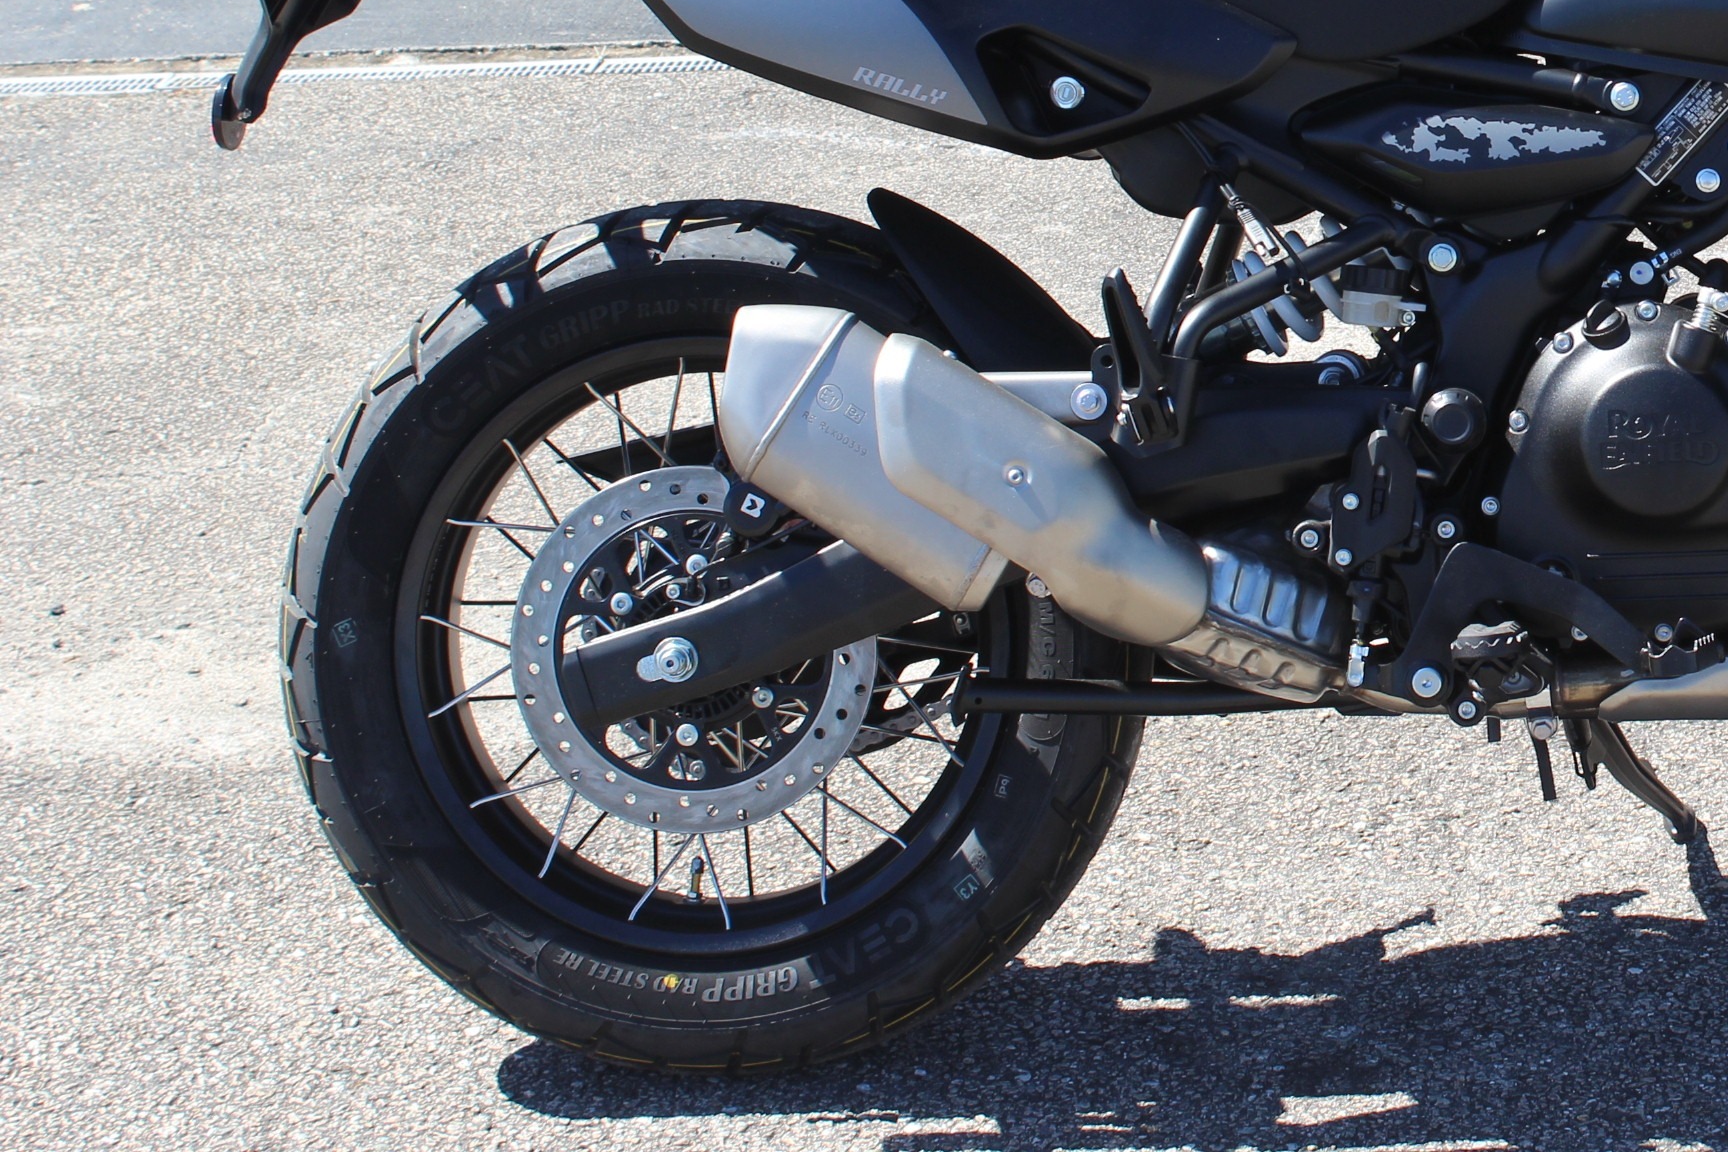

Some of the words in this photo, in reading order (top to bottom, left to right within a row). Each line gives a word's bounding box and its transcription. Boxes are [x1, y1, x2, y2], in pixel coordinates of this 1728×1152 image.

[852, 66, 948, 105] RALLY
[538, 299, 632, 350] GRIPP
[687, 297, 738, 315] STEE
[551, 947, 586, 971] RE
[809, 909, 920, 988] CEAT
[587, 957, 650, 990] STEEL
[653, 972, 699, 996] RAD
[700, 964, 799, 1003] GRIPP
